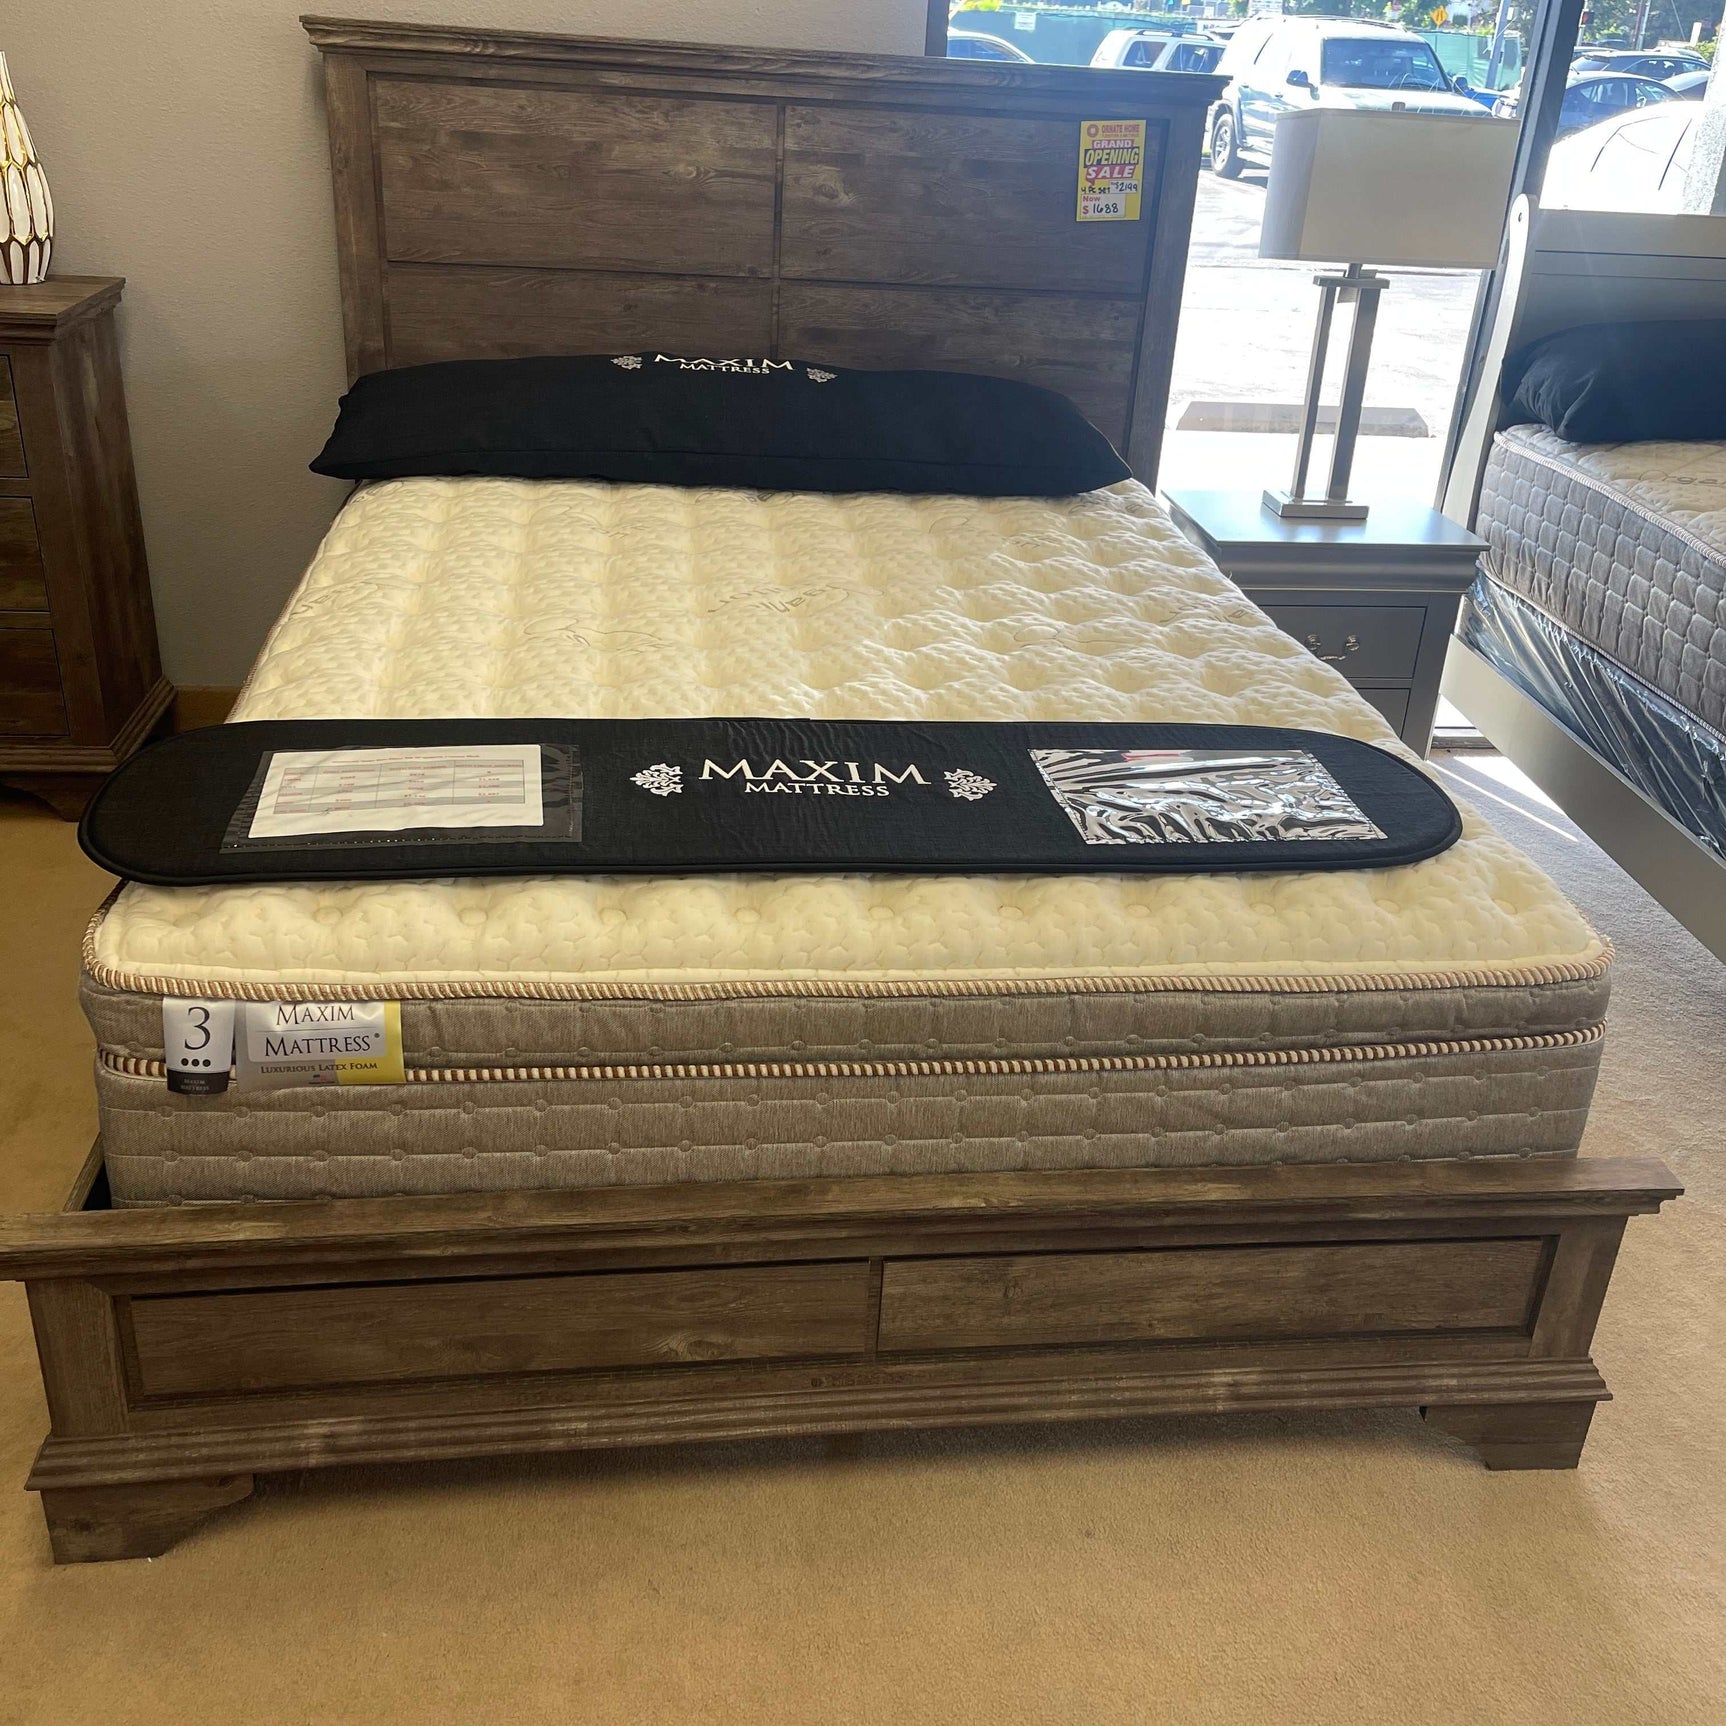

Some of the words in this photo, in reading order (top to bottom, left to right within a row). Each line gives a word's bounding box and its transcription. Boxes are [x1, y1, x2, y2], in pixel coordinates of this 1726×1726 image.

[1123, 124, 1140, 132] HOME
[1086, 149, 1139, 165] OPENING
[1087, 166, 1133, 178] SALE
[1092, 203, 1119, 214] 1688
[654, 353, 796, 371] MAXIM
[679, 363, 771, 374] MATTRESS
[698, 758, 932, 785] MAXIM
[744, 781, 890, 797] MATTRESS
[276, 1004, 355, 1026] MAXIM
[183, 1006, 211, 1051] 3
[265, 1034, 371, 1057] MATTRESS
[260, 1064, 316, 1074] LUXURIOUS
[318, 1063, 347, 1072] LATEX
[350, 1062, 378, 1071] FOAM
